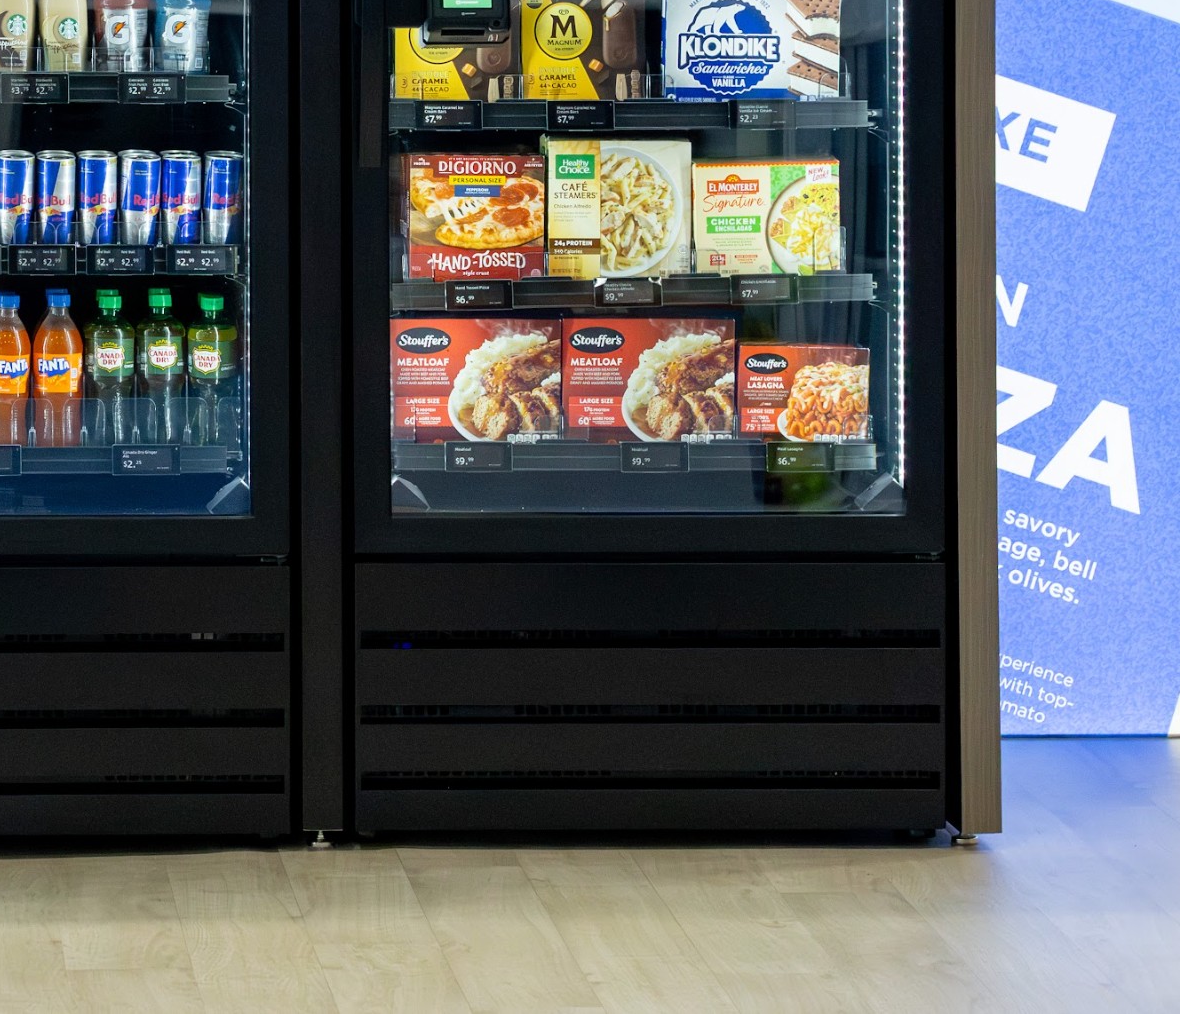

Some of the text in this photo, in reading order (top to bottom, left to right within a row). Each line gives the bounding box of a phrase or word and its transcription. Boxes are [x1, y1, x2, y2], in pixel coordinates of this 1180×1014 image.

[550, 15, 576, 38] M
[680, 35, 778, 67] KLONDIKE
[692, 62, 767, 75] Sandwiches
[712, 79, 746, 87] VANILLA
[559, 166, 591, 175] Choice
[563, 160, 589, 169] Healthy
[562, 181, 588, 191] CAFÉ
[709, 182, 758, 192] EL MONTEREY
[134, 195, 154, 205] Red
[703, 194, 764, 213] Signature
[399, 335, 448, 347] Stouffer's
[572, 334, 622, 347] Stouffer's
[38, 358, 70, 372] FANTA
[397, 358, 449, 366] MEATLOAF
[571, 358, 623, 366] MEATLOAF
[747, 358, 787, 370] Stouffer's
[1003, 509, 1080, 548] savory
[1053, 551, 1097, 580] bell
[1008, 566, 1079, 604] olives.
